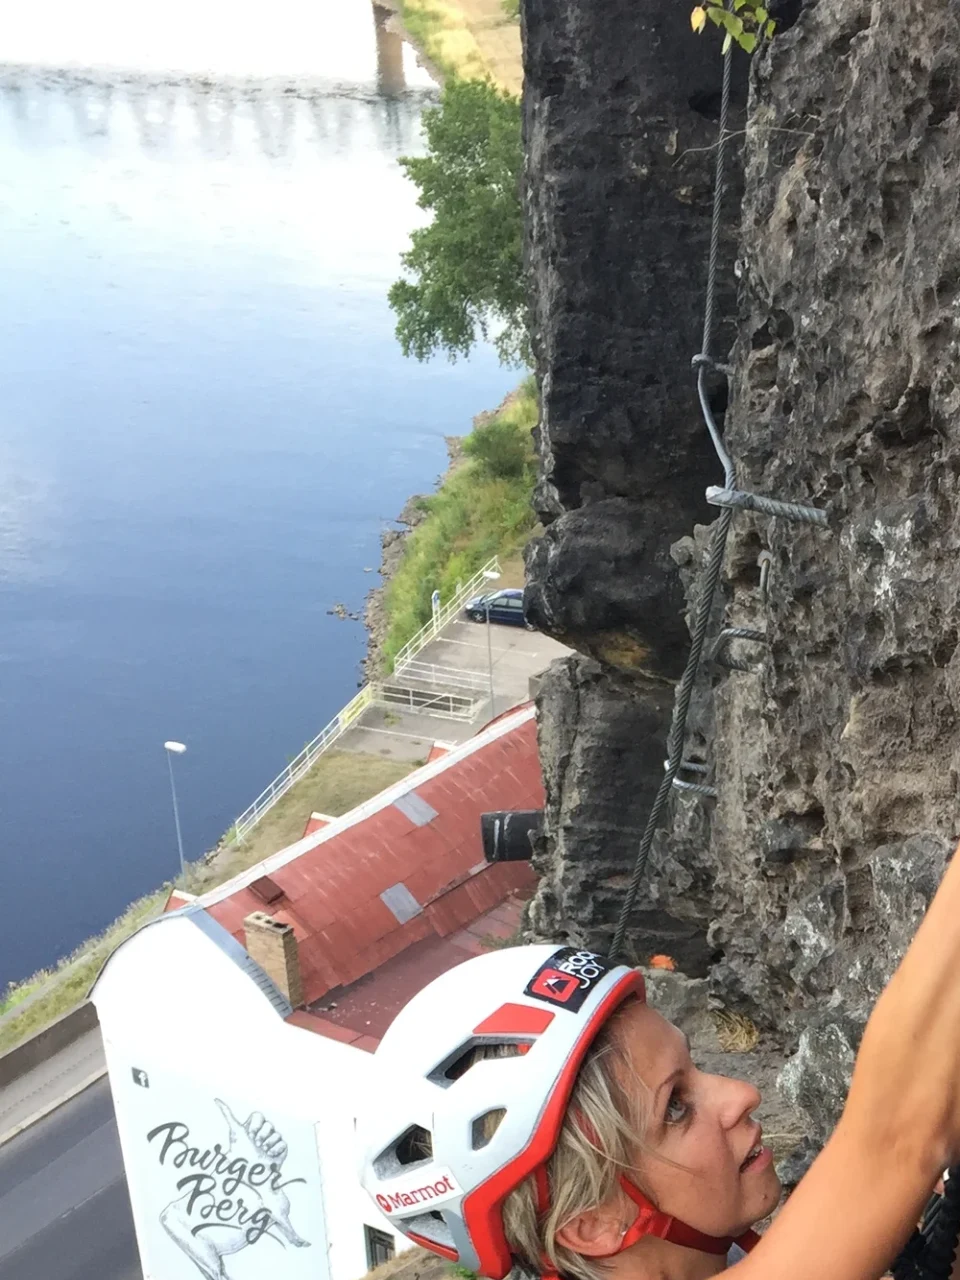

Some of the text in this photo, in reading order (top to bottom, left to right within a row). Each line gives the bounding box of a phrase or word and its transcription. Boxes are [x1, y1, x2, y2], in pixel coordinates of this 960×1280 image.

[574, 960, 605, 989] JOY
[147, 1122, 307, 1197] Burger
[176, 1173, 276, 1247] Berg
[386, 1174, 456, 1209] Marmot
